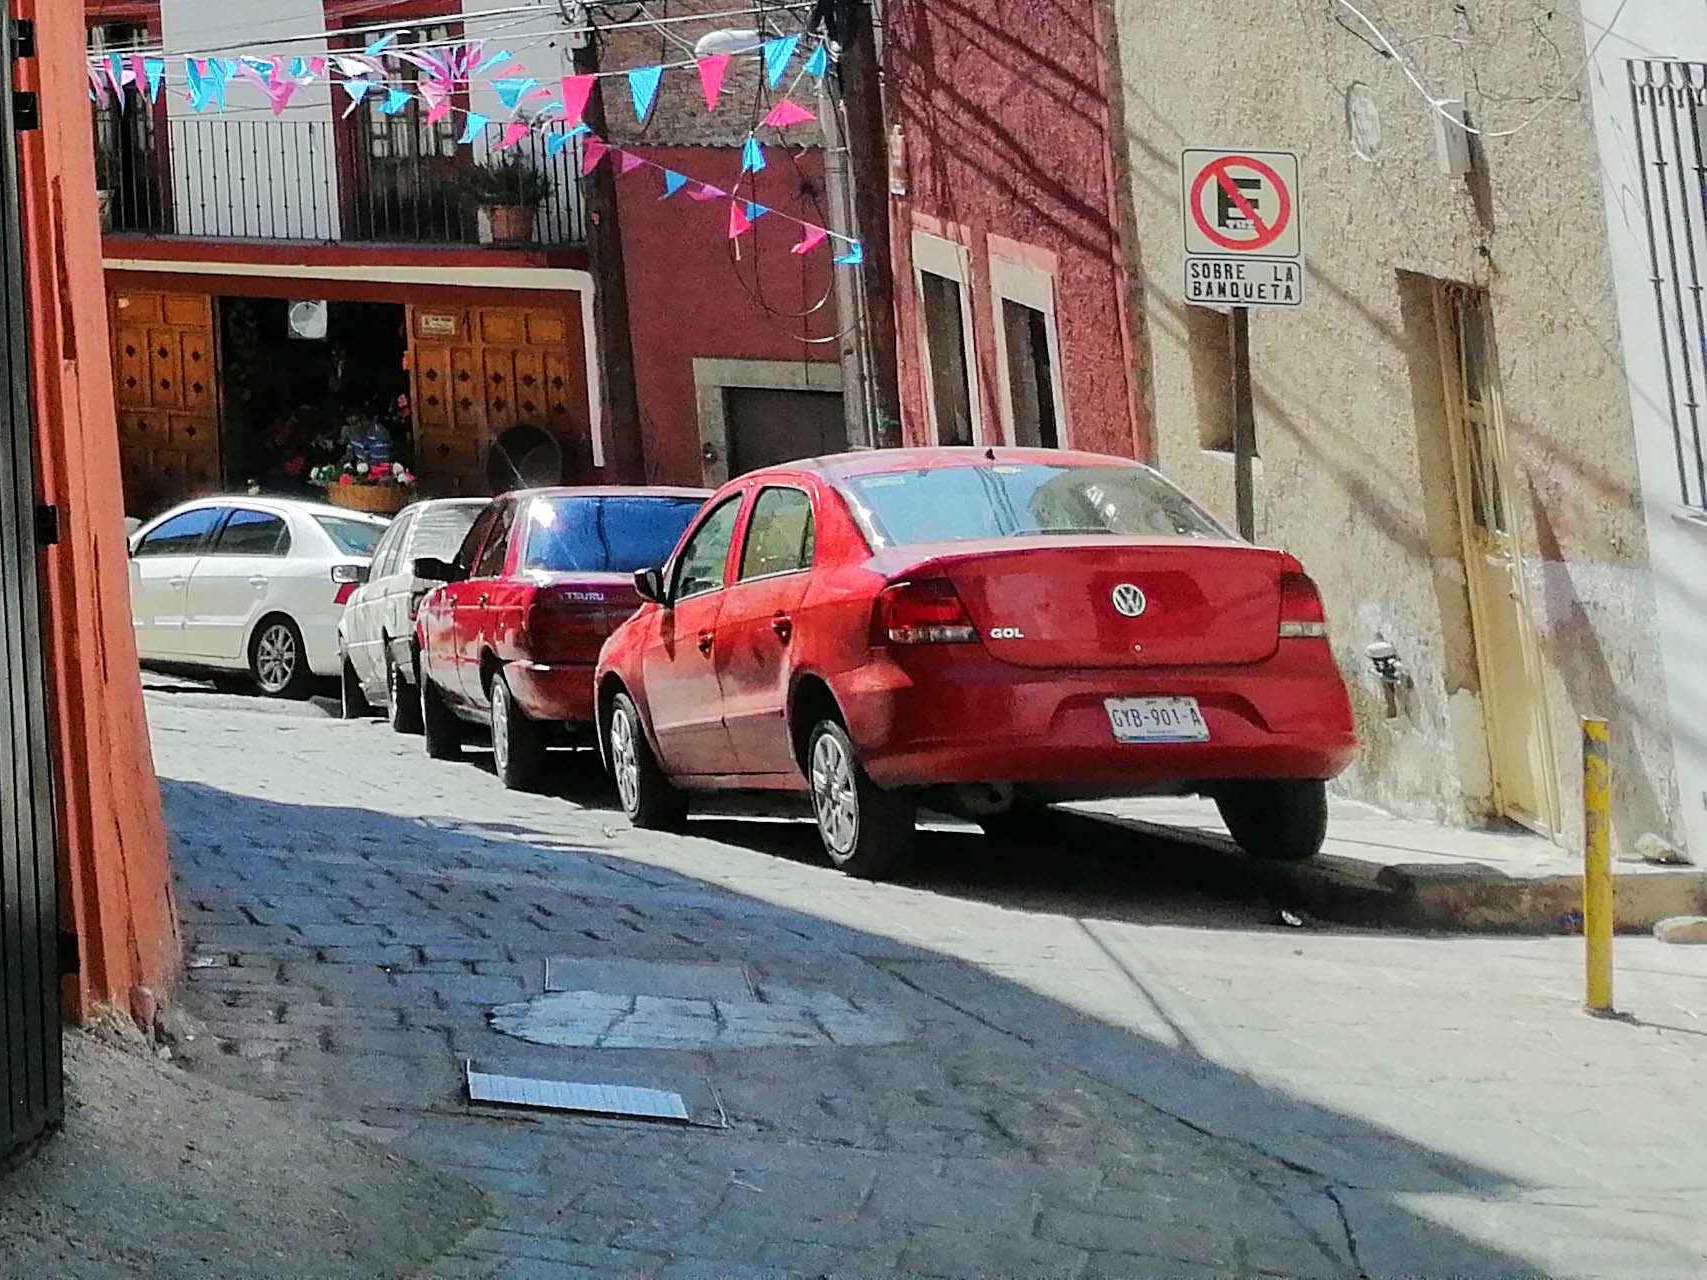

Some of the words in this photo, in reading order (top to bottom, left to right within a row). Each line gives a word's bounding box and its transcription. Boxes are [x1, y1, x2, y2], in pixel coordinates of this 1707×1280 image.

[1190, 262, 1246, 281] SOBRE
[1273, 265, 1295, 282] LA
[1193, 281, 1294, 301] BANQUETA
[564, 592, 605, 601] TSURU
[989, 627, 1025, 639] GOL
[1111, 707, 1202, 728] GYB-901-A
